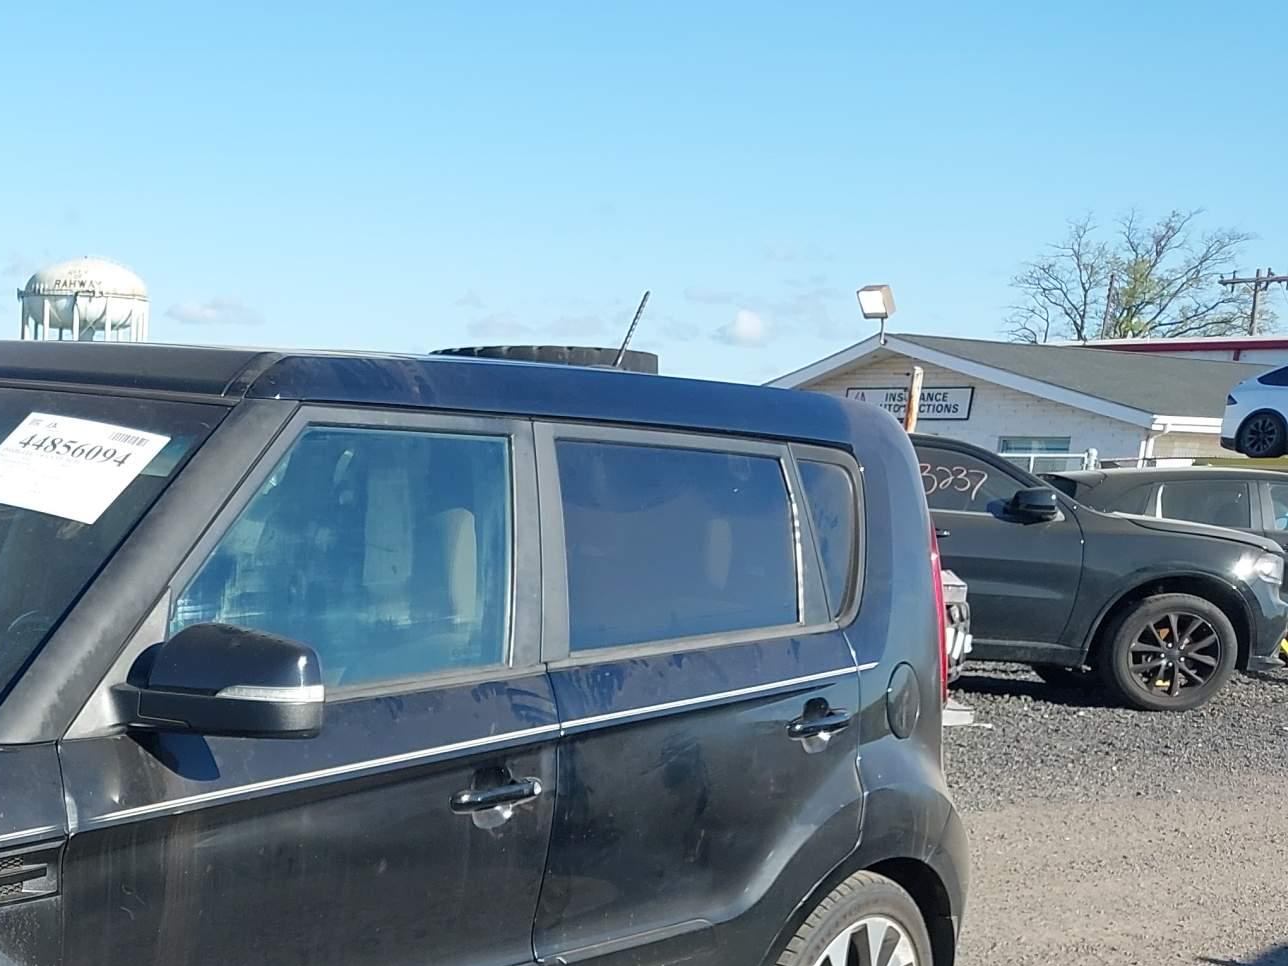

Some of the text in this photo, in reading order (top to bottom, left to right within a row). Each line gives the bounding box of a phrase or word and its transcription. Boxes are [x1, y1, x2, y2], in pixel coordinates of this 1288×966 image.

[54, 279, 102, 288] RAHWAY
[885, 392, 949, 402] INSANCE
[19, 434, 133, 467] 44856094
